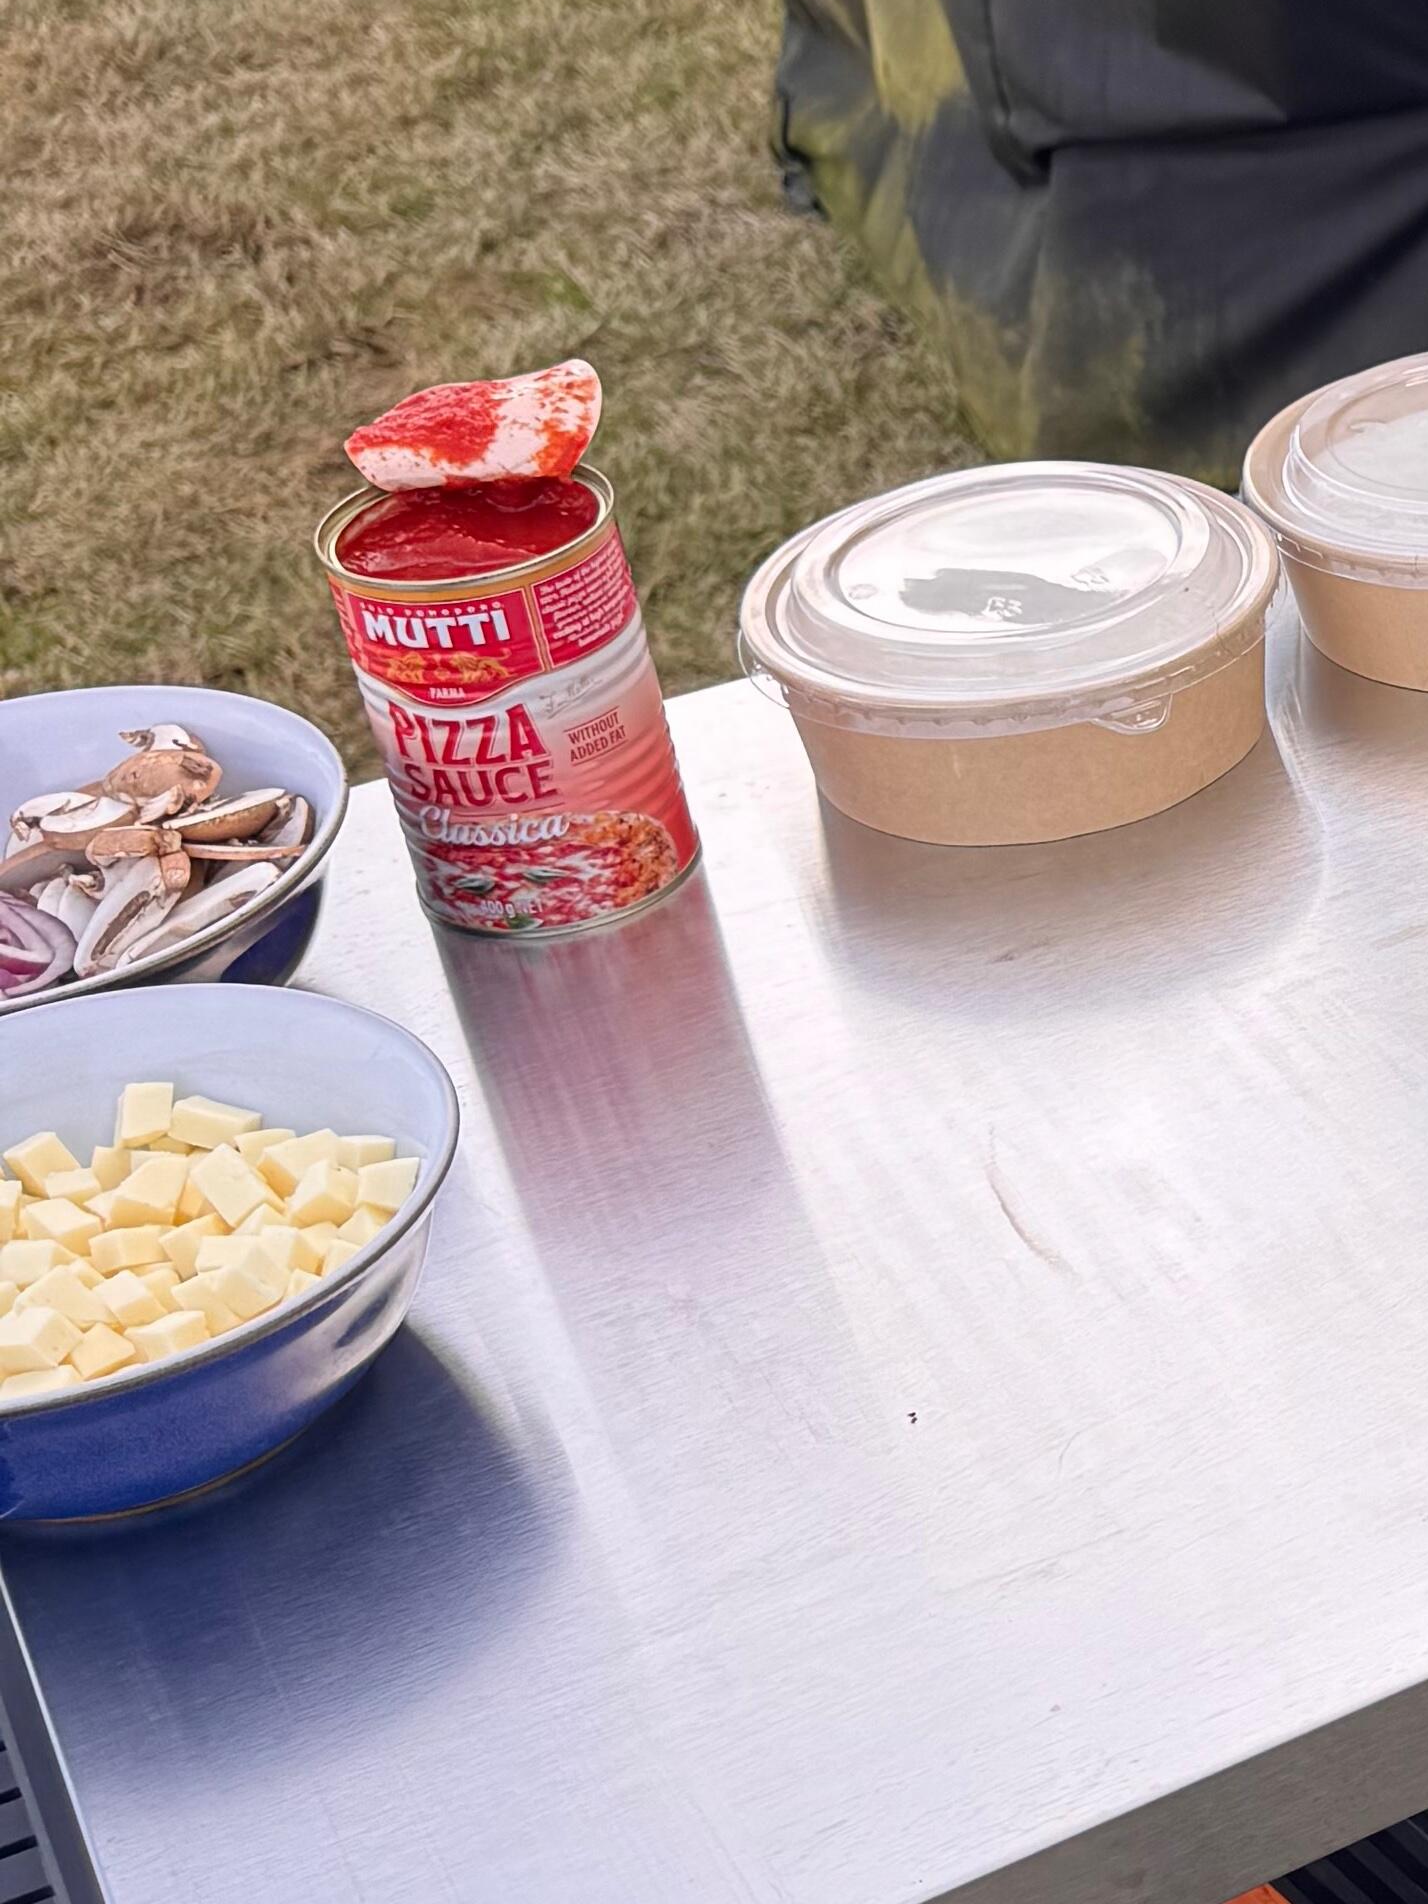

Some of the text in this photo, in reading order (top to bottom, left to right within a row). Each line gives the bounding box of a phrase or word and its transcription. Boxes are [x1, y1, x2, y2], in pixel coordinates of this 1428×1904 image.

[361, 609, 511, 649] MUTTI
[388, 700, 547, 765] PIZZA
[568, 712, 619, 744] WITHOUT
[570, 725, 626, 762] ADDED FAT
[404, 760, 557, 807] SAUCE
[420, 805, 570, 846] Classica
